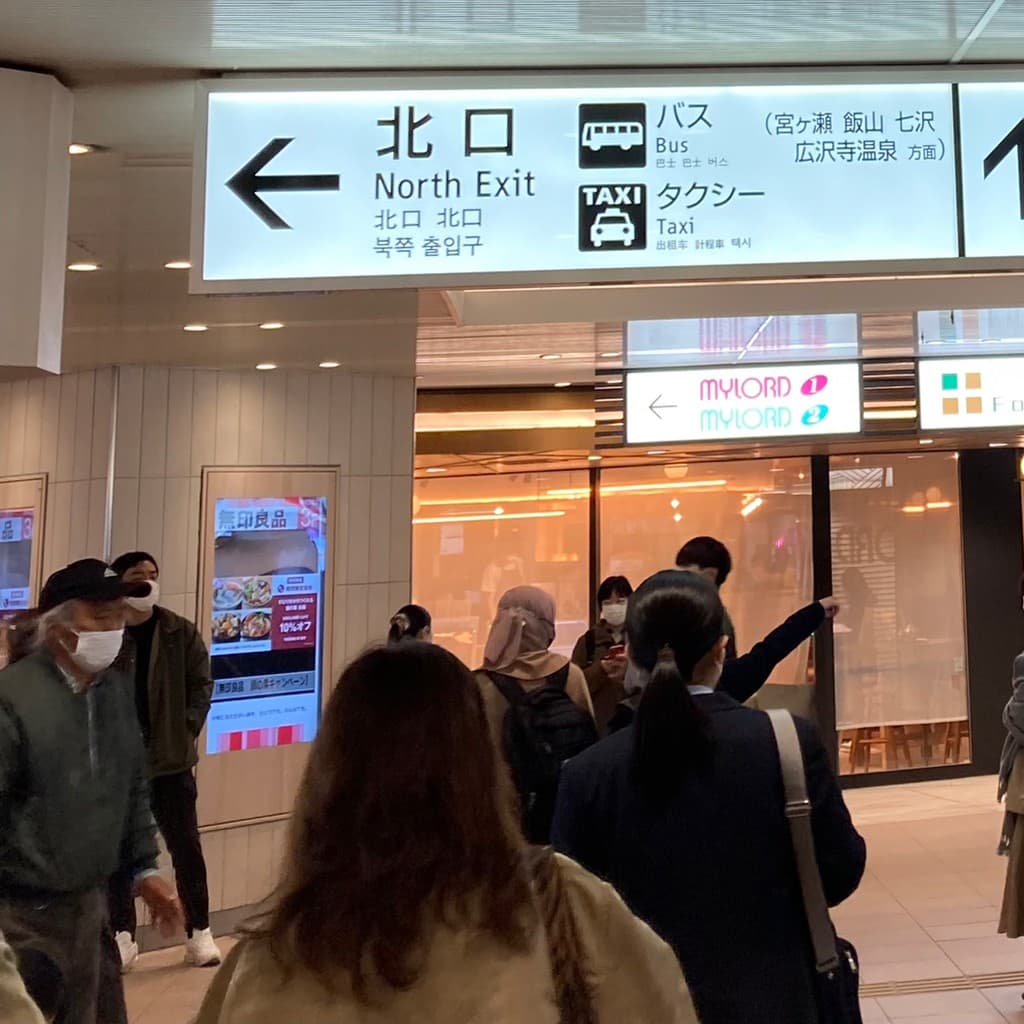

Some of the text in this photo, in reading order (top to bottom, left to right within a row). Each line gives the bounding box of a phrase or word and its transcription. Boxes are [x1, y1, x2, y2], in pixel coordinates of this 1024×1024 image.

[656, 102, 712, 128] バス
[843, 112, 884, 134] 飯山
[895, 111, 935, 133] 七沢
[376, 105, 514, 160] 北口
[656, 137, 689, 153] Bus
[795, 139, 898, 163] 広沢寺温泉
[374, 169, 536, 200] North Exit
[582, 186, 641, 205] TAXI
[657, 182, 765, 210] タクシー
[375, 207, 482, 230] 北口 北口
[656, 217, 694, 234] Taxi
[373, 235, 483, 258] 북쪽 출입구
[700, 376, 791, 400] MYLORD
[700, 405, 792, 432] MYLORD
